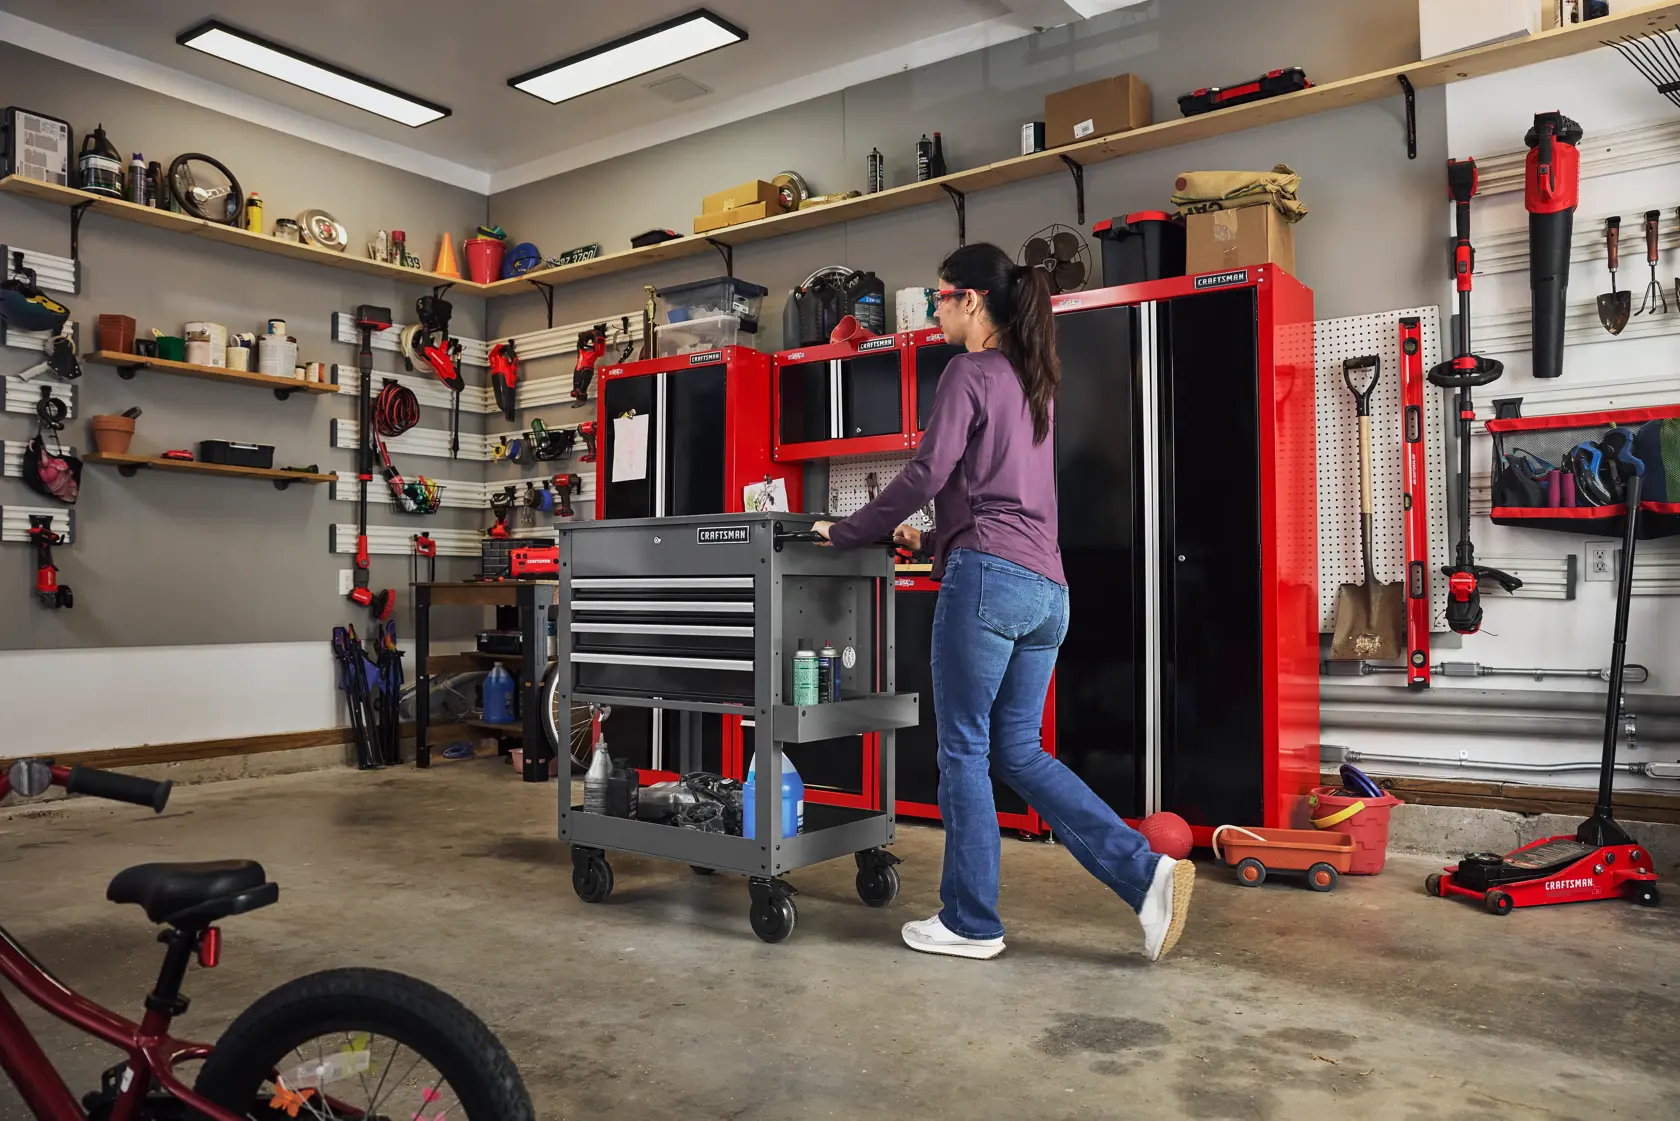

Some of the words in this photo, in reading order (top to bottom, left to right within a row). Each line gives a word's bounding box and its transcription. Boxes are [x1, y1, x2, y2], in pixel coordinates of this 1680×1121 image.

[1197, 272, 1244, 286] CRAFTSMAN
[860, 339, 892, 350] CRAFTSMAN
[691, 353, 720, 363] CRAFTSMAN
[700, 530, 746, 540] CRAFTSMAN
[1545, 878, 1593, 891] CRAFTSMAN
